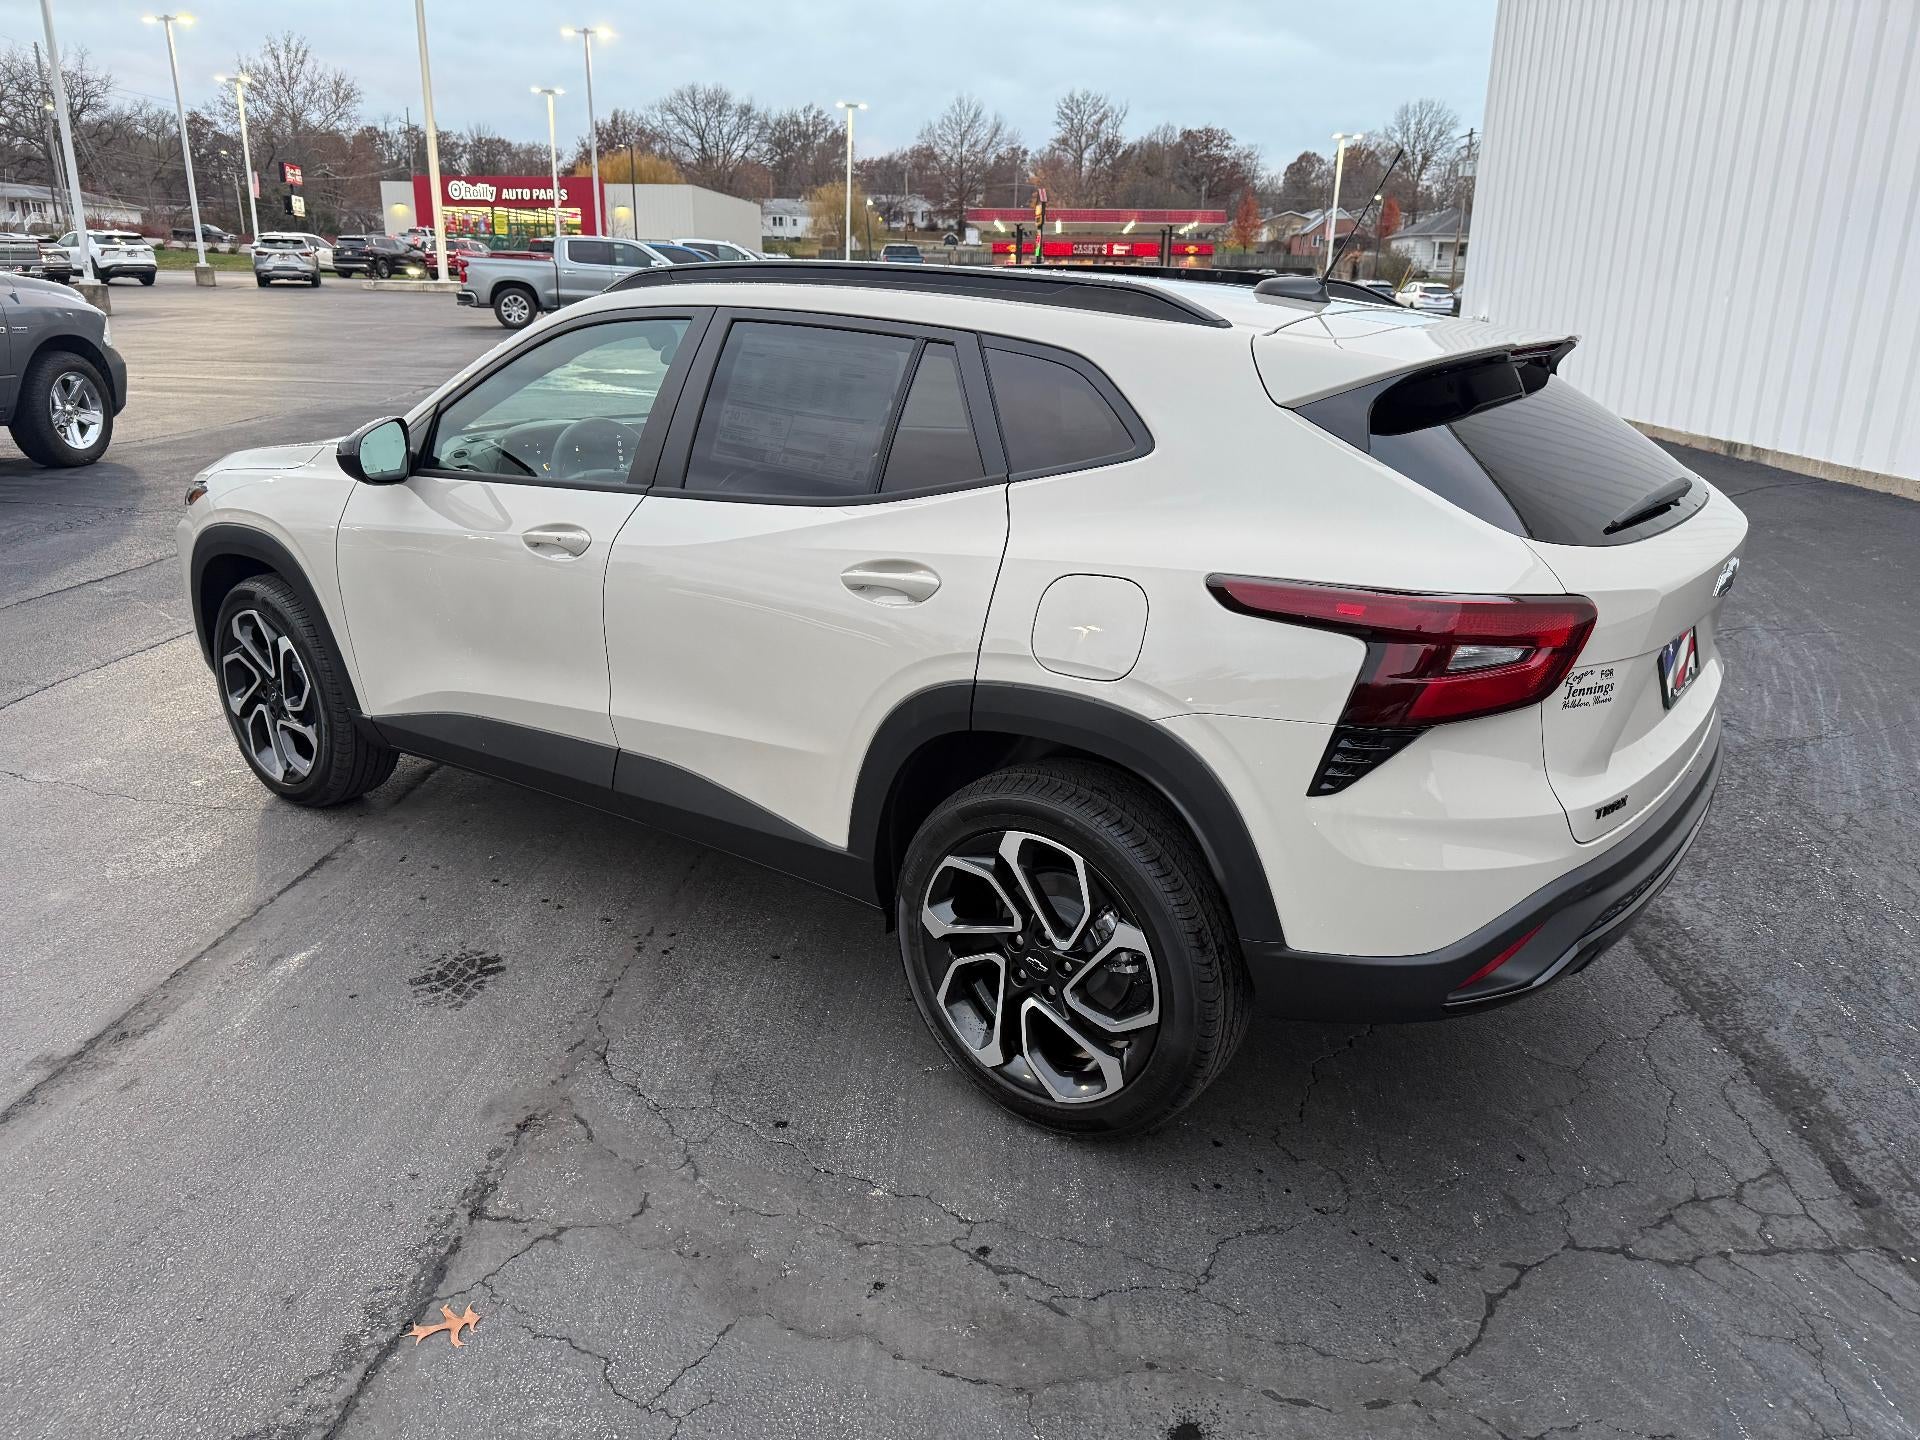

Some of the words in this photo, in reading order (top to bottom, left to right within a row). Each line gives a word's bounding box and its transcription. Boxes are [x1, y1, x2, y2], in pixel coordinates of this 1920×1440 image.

[448, 180, 496, 202] O'Reilly
[502, 189, 530, 200] AUTO
[533, 189, 568, 200] PARS
[1073, 244, 1107, 255] CASEY'S
[1565, 669, 1596, 687] Roger
[1564, 682, 1615, 700] Jennings
